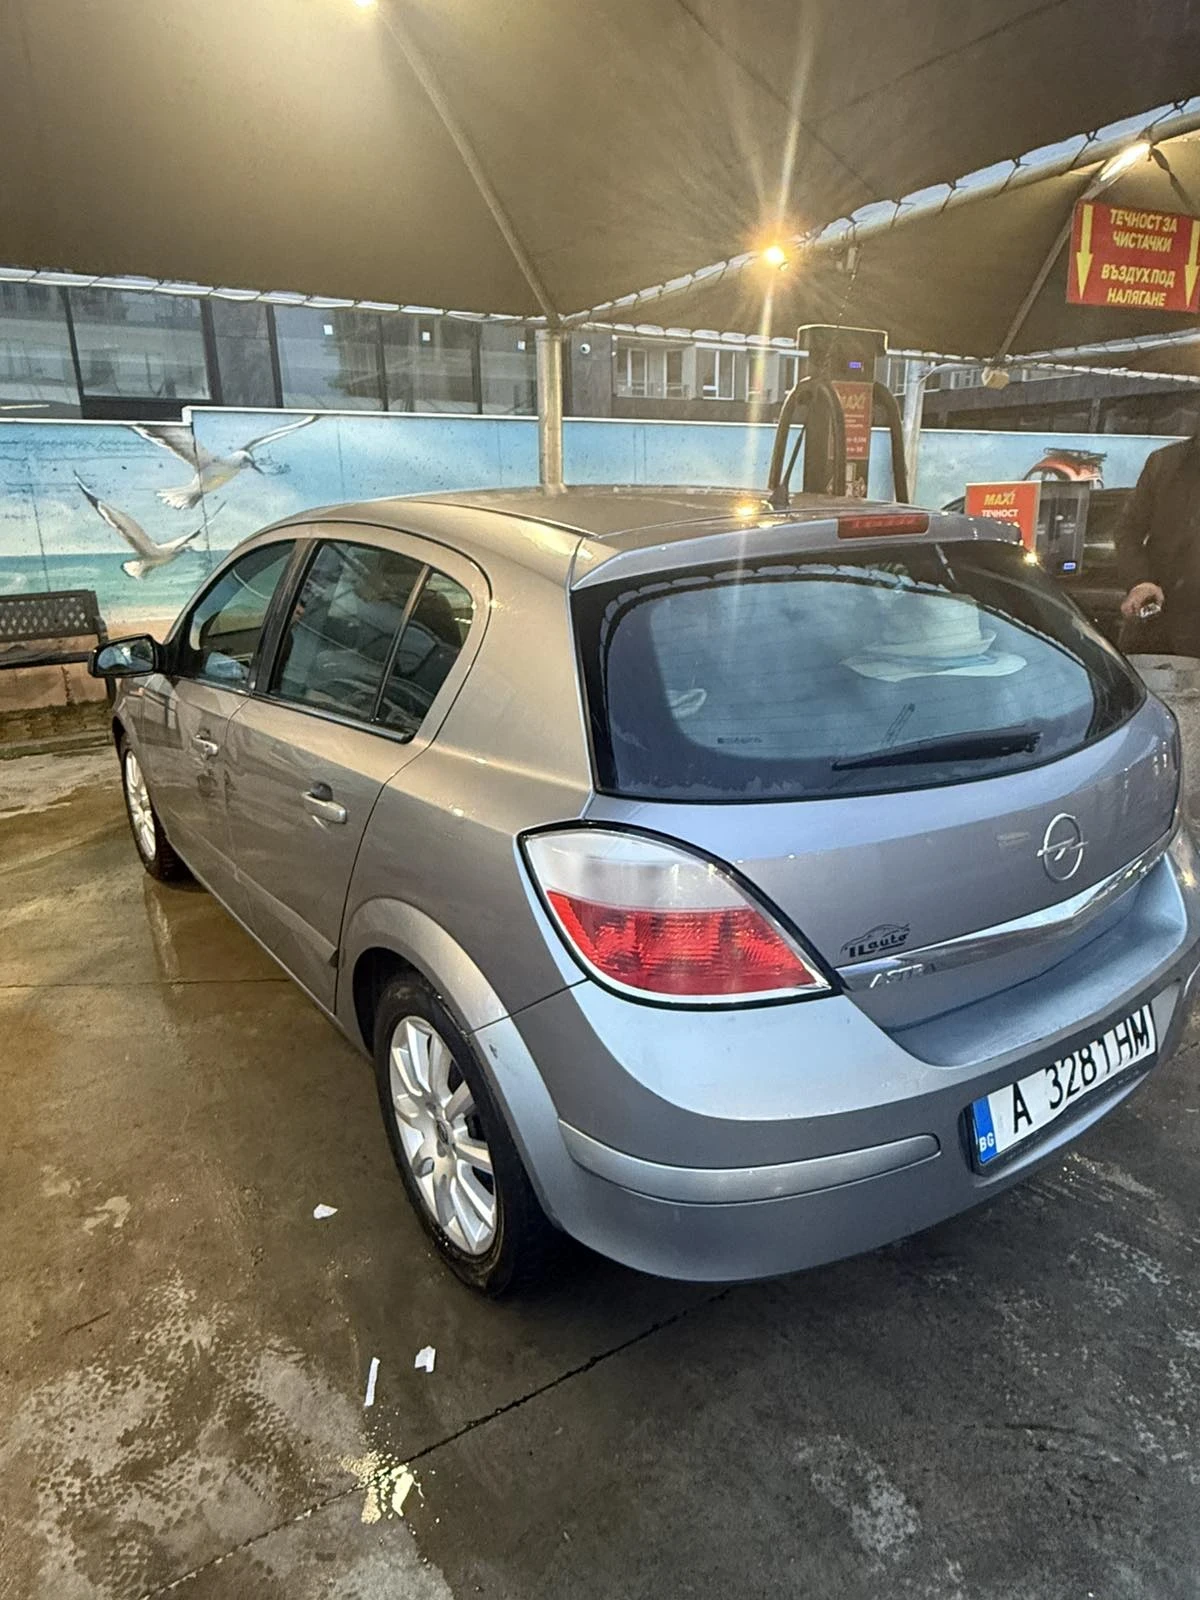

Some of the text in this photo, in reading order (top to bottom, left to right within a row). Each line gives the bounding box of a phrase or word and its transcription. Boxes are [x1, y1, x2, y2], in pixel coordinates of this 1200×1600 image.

[1110, 208, 1177, 233] ТЕЧНОСТ ЗА
[1112, 231, 1172, 253] ЧИСТАЧКИ
[1101, 263, 1176, 288] ВЪЗДУХ ПОД
[1106, 287, 1167, 307] НАЛЯГАНЕ
[983, 491, 1016, 506] MAXI
[981, 508, 1019, 518] ТЕЧНОСТ
[1012, 1082, 1033, 1134] A
[1045, 1036, 1111, 1110] 3281
[979, 1131, 995, 1152] BG
